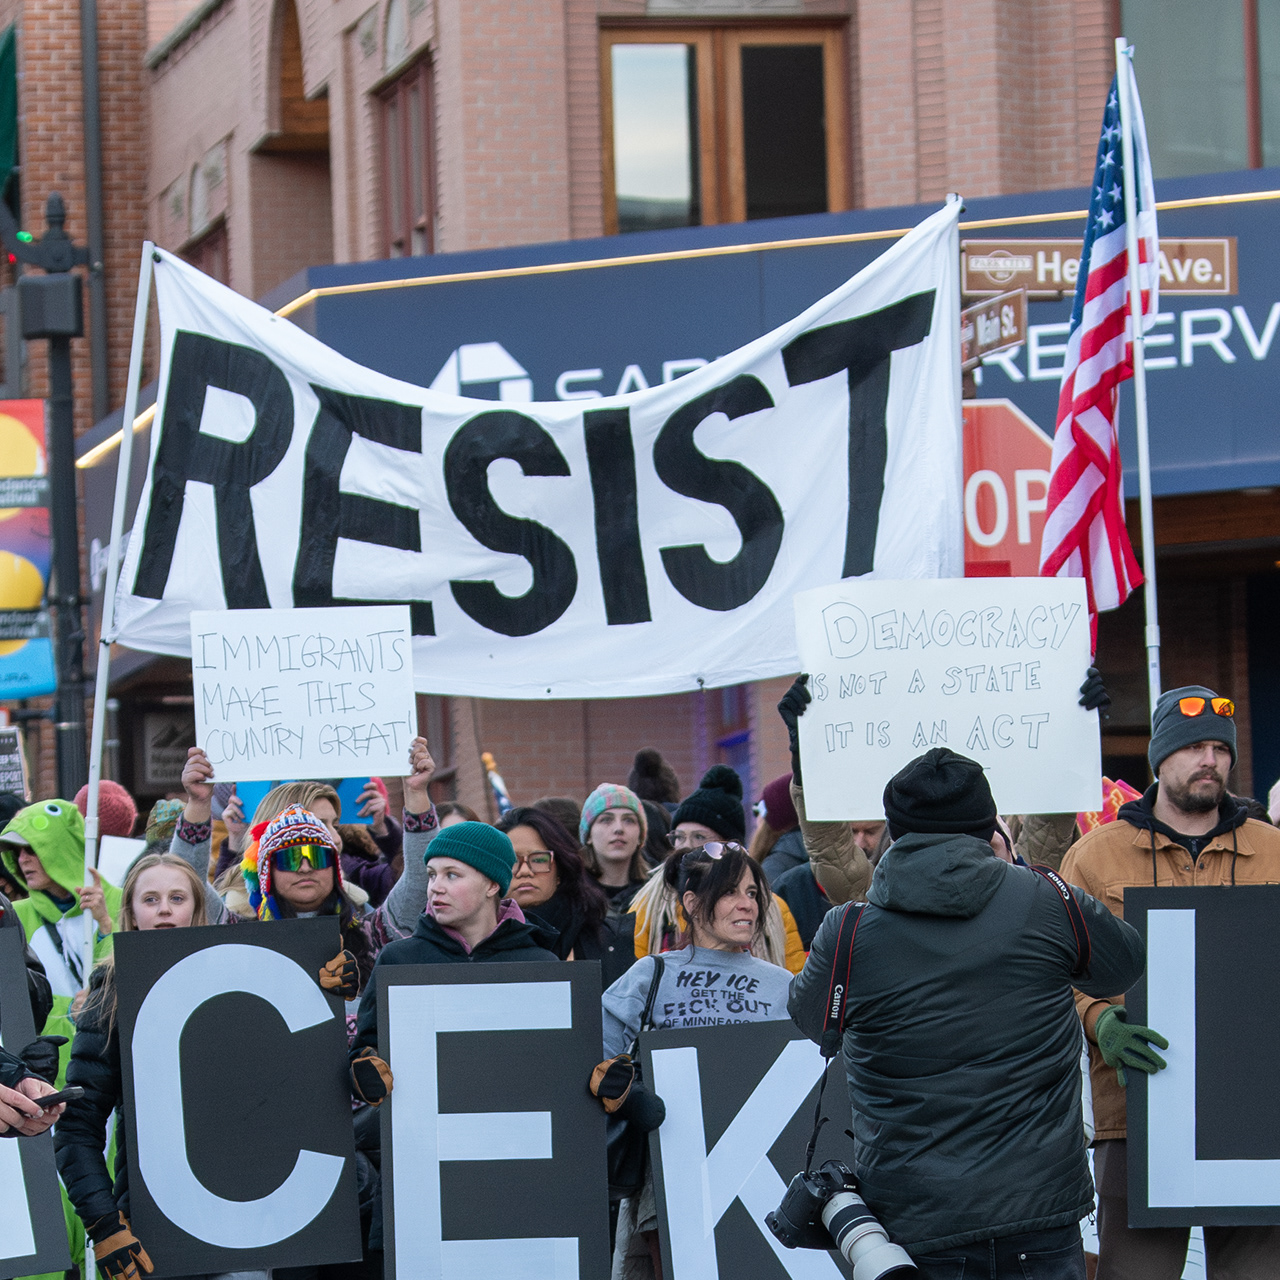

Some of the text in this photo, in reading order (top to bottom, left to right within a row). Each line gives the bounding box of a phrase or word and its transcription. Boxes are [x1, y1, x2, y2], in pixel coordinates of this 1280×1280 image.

[1158, 251, 1223, 283] Ave.
[130, 287, 937, 638] RESIST
[963, 469, 1051, 547] OP
[194, 628, 406, 672] IMMIGRANTS
[821, 601, 1082, 659] DEMOCRACY
[839, 670, 888, 700] NOT
[908, 668, 927, 694] A
[941, 660, 1043, 697] STATE
[202, 680, 376, 725] MAKE THIS
[204, 708, 413, 765] COUNTRY GREAT!
[824, 712, 1051, 754] IT IS AN ACT
[1047, 871, 1070, 900] Canon
[676, 970, 760, 994] HEY ICE
[690, 988, 745, 1001] GET THE
[830, 984, 844, 1019] Canon
[663, 1017, 680, 1028] OF
[726, 999, 772, 1017] OUT
[131, 943, 346, 1250] C
